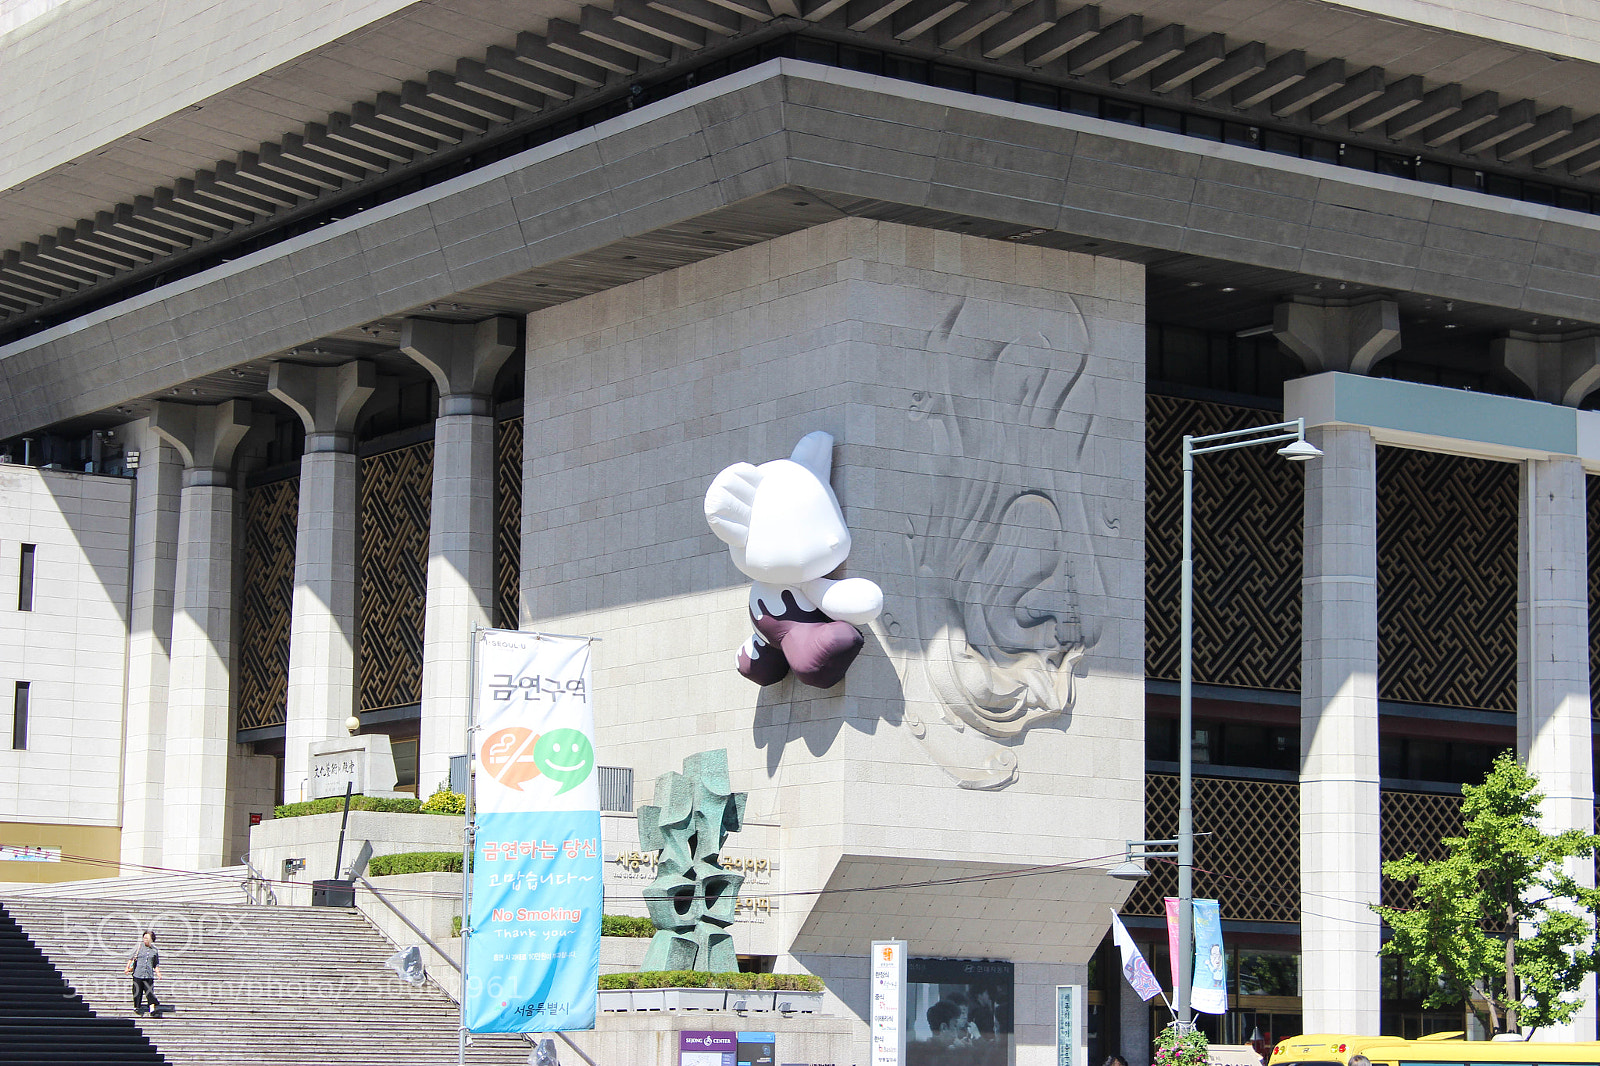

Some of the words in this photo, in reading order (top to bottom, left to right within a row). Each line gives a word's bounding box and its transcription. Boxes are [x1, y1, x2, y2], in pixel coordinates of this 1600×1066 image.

[488, 673, 587, 704] 금연구역
[481, 839, 558, 862] 금연하는
[562, 837, 597, 859] 당신
[717, 854, 771, 875] 공이야기
[491, 908, 514, 922] No
[516, 907, 582, 924] Smoking
[493, 928, 537, 939] Thank
[514, 1001, 570, 1018] 서울특별시
